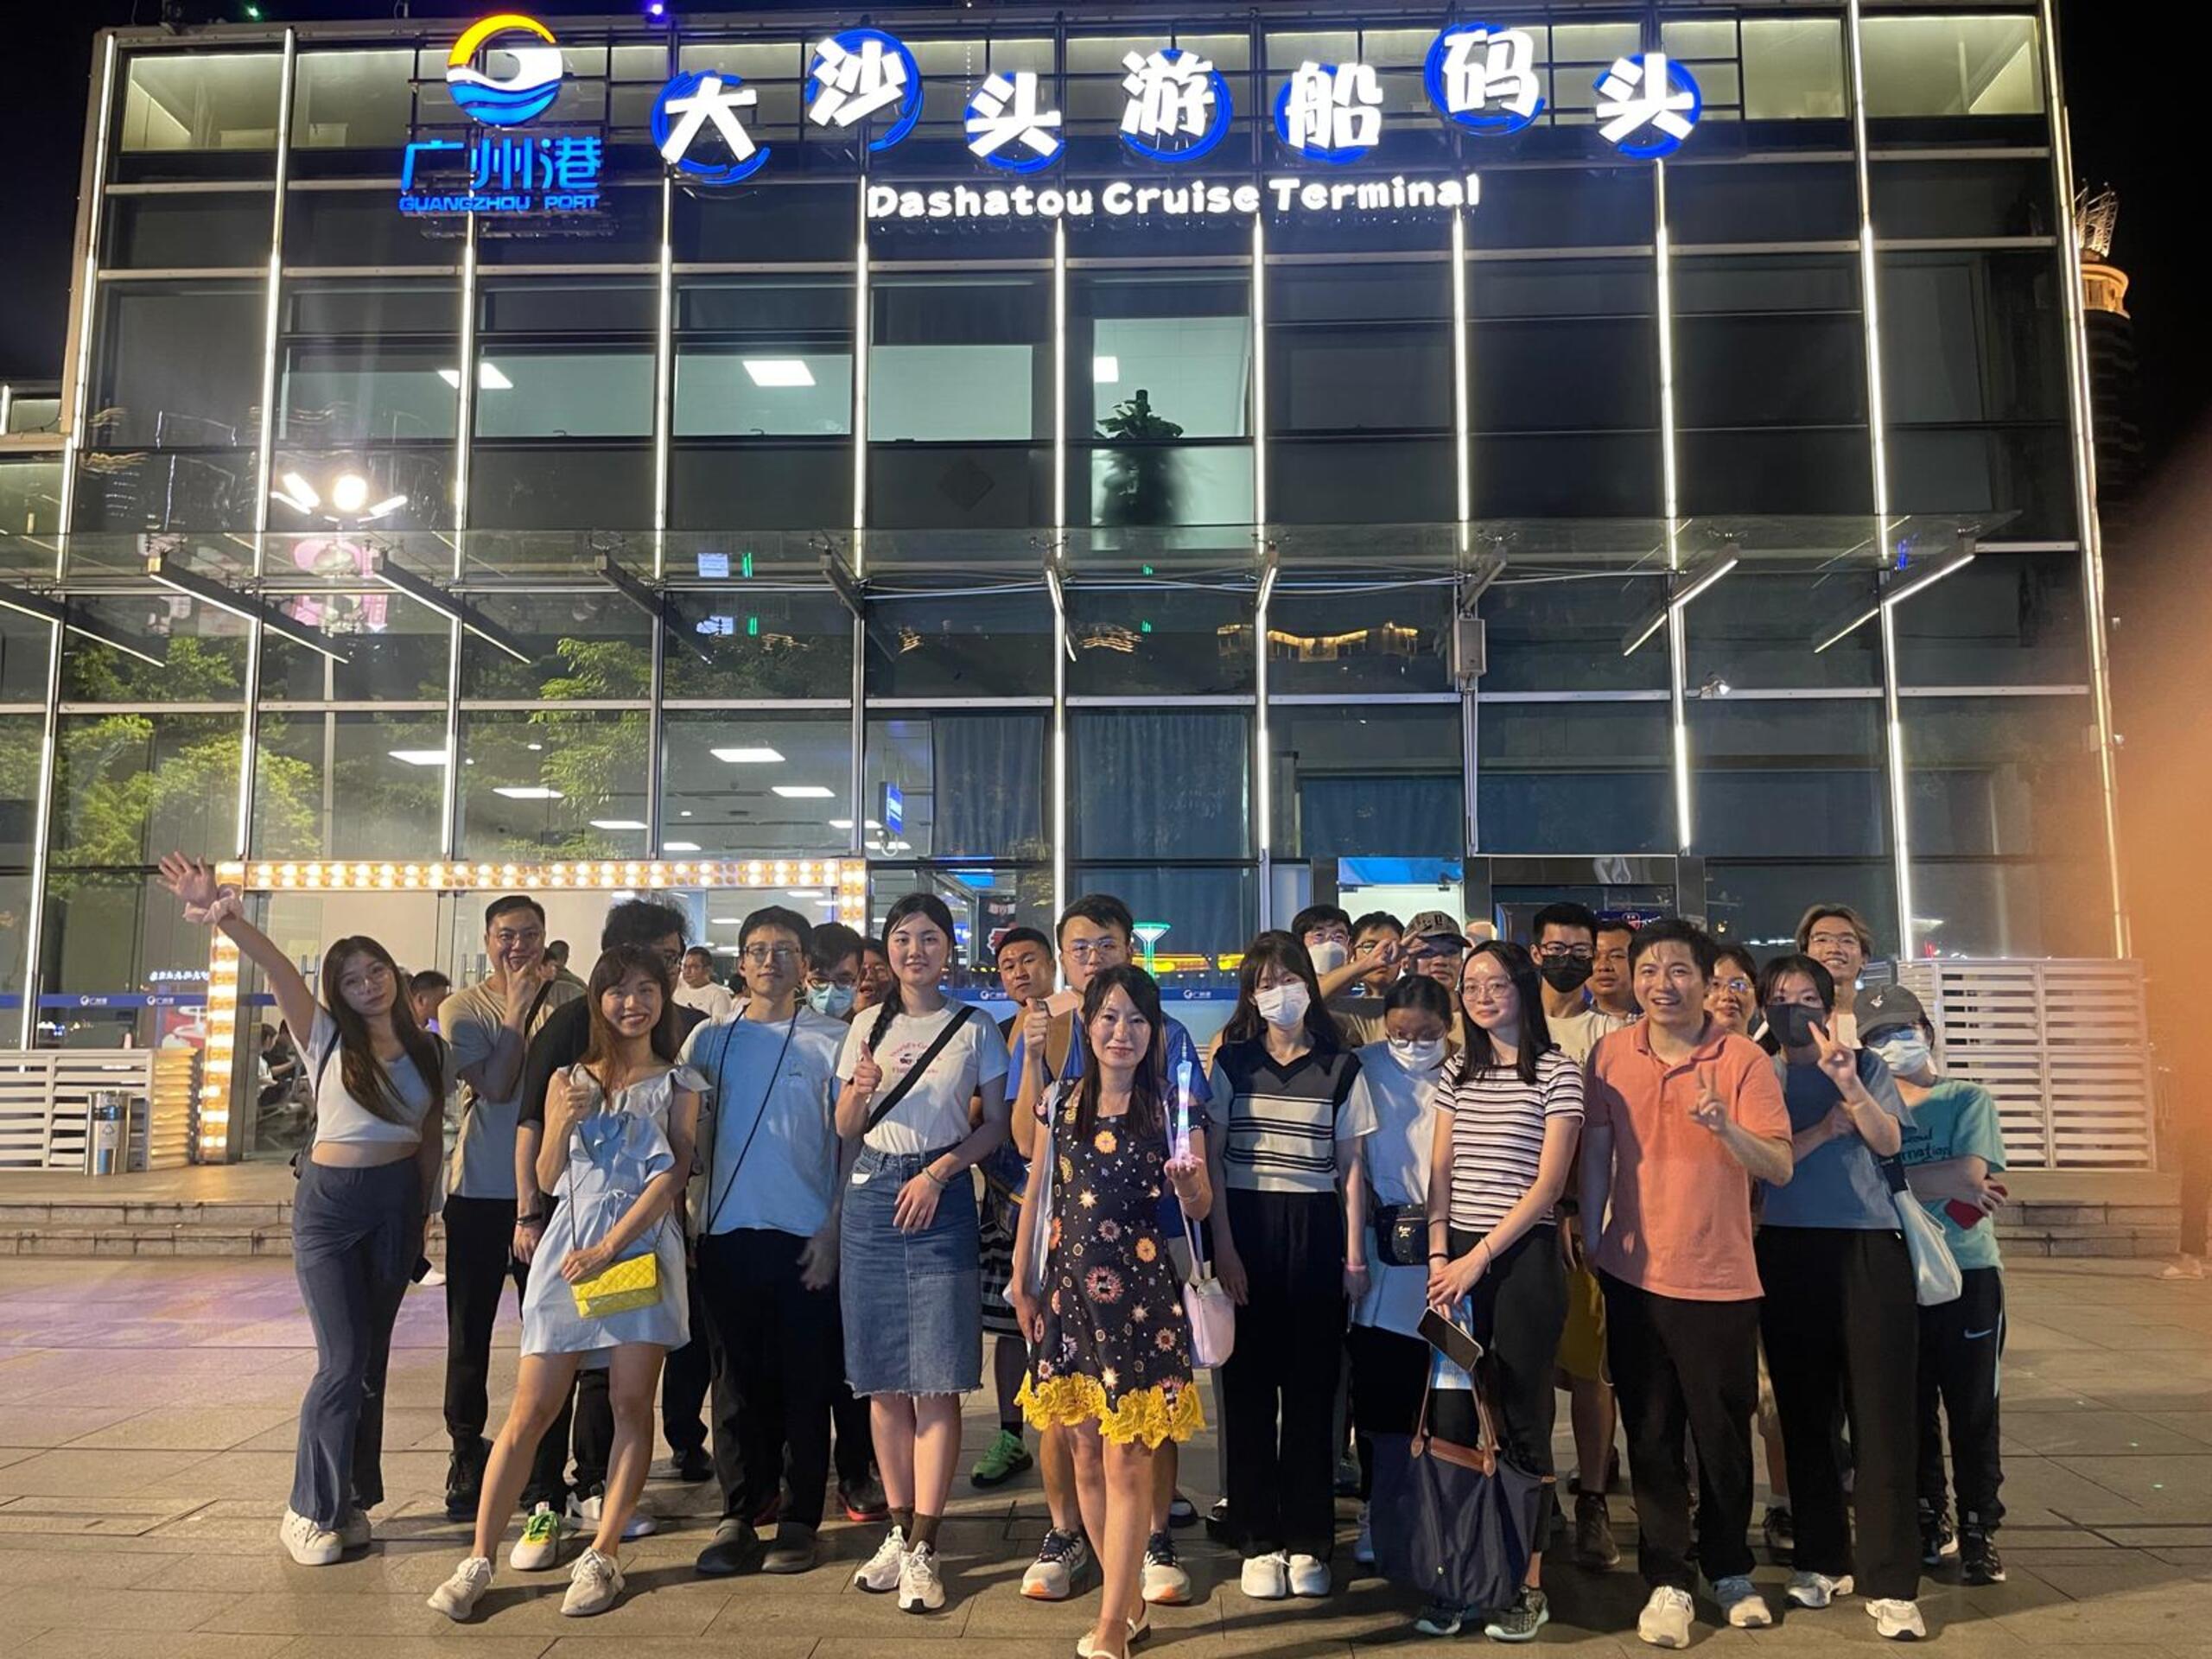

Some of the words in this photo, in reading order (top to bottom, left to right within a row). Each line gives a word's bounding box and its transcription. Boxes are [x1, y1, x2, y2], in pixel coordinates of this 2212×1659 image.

[661, 29, 1694, 165] 大沙头游船码头
[401, 136, 602, 190] 广州港
[399, 196, 531, 212] GUANGZHOU
[543, 194, 601, 211] PORT
[867, 184, 1094, 218] Dashatou
[1102, 179, 1261, 215] Cruise
[1268, 173, 1480, 210] Terminal
